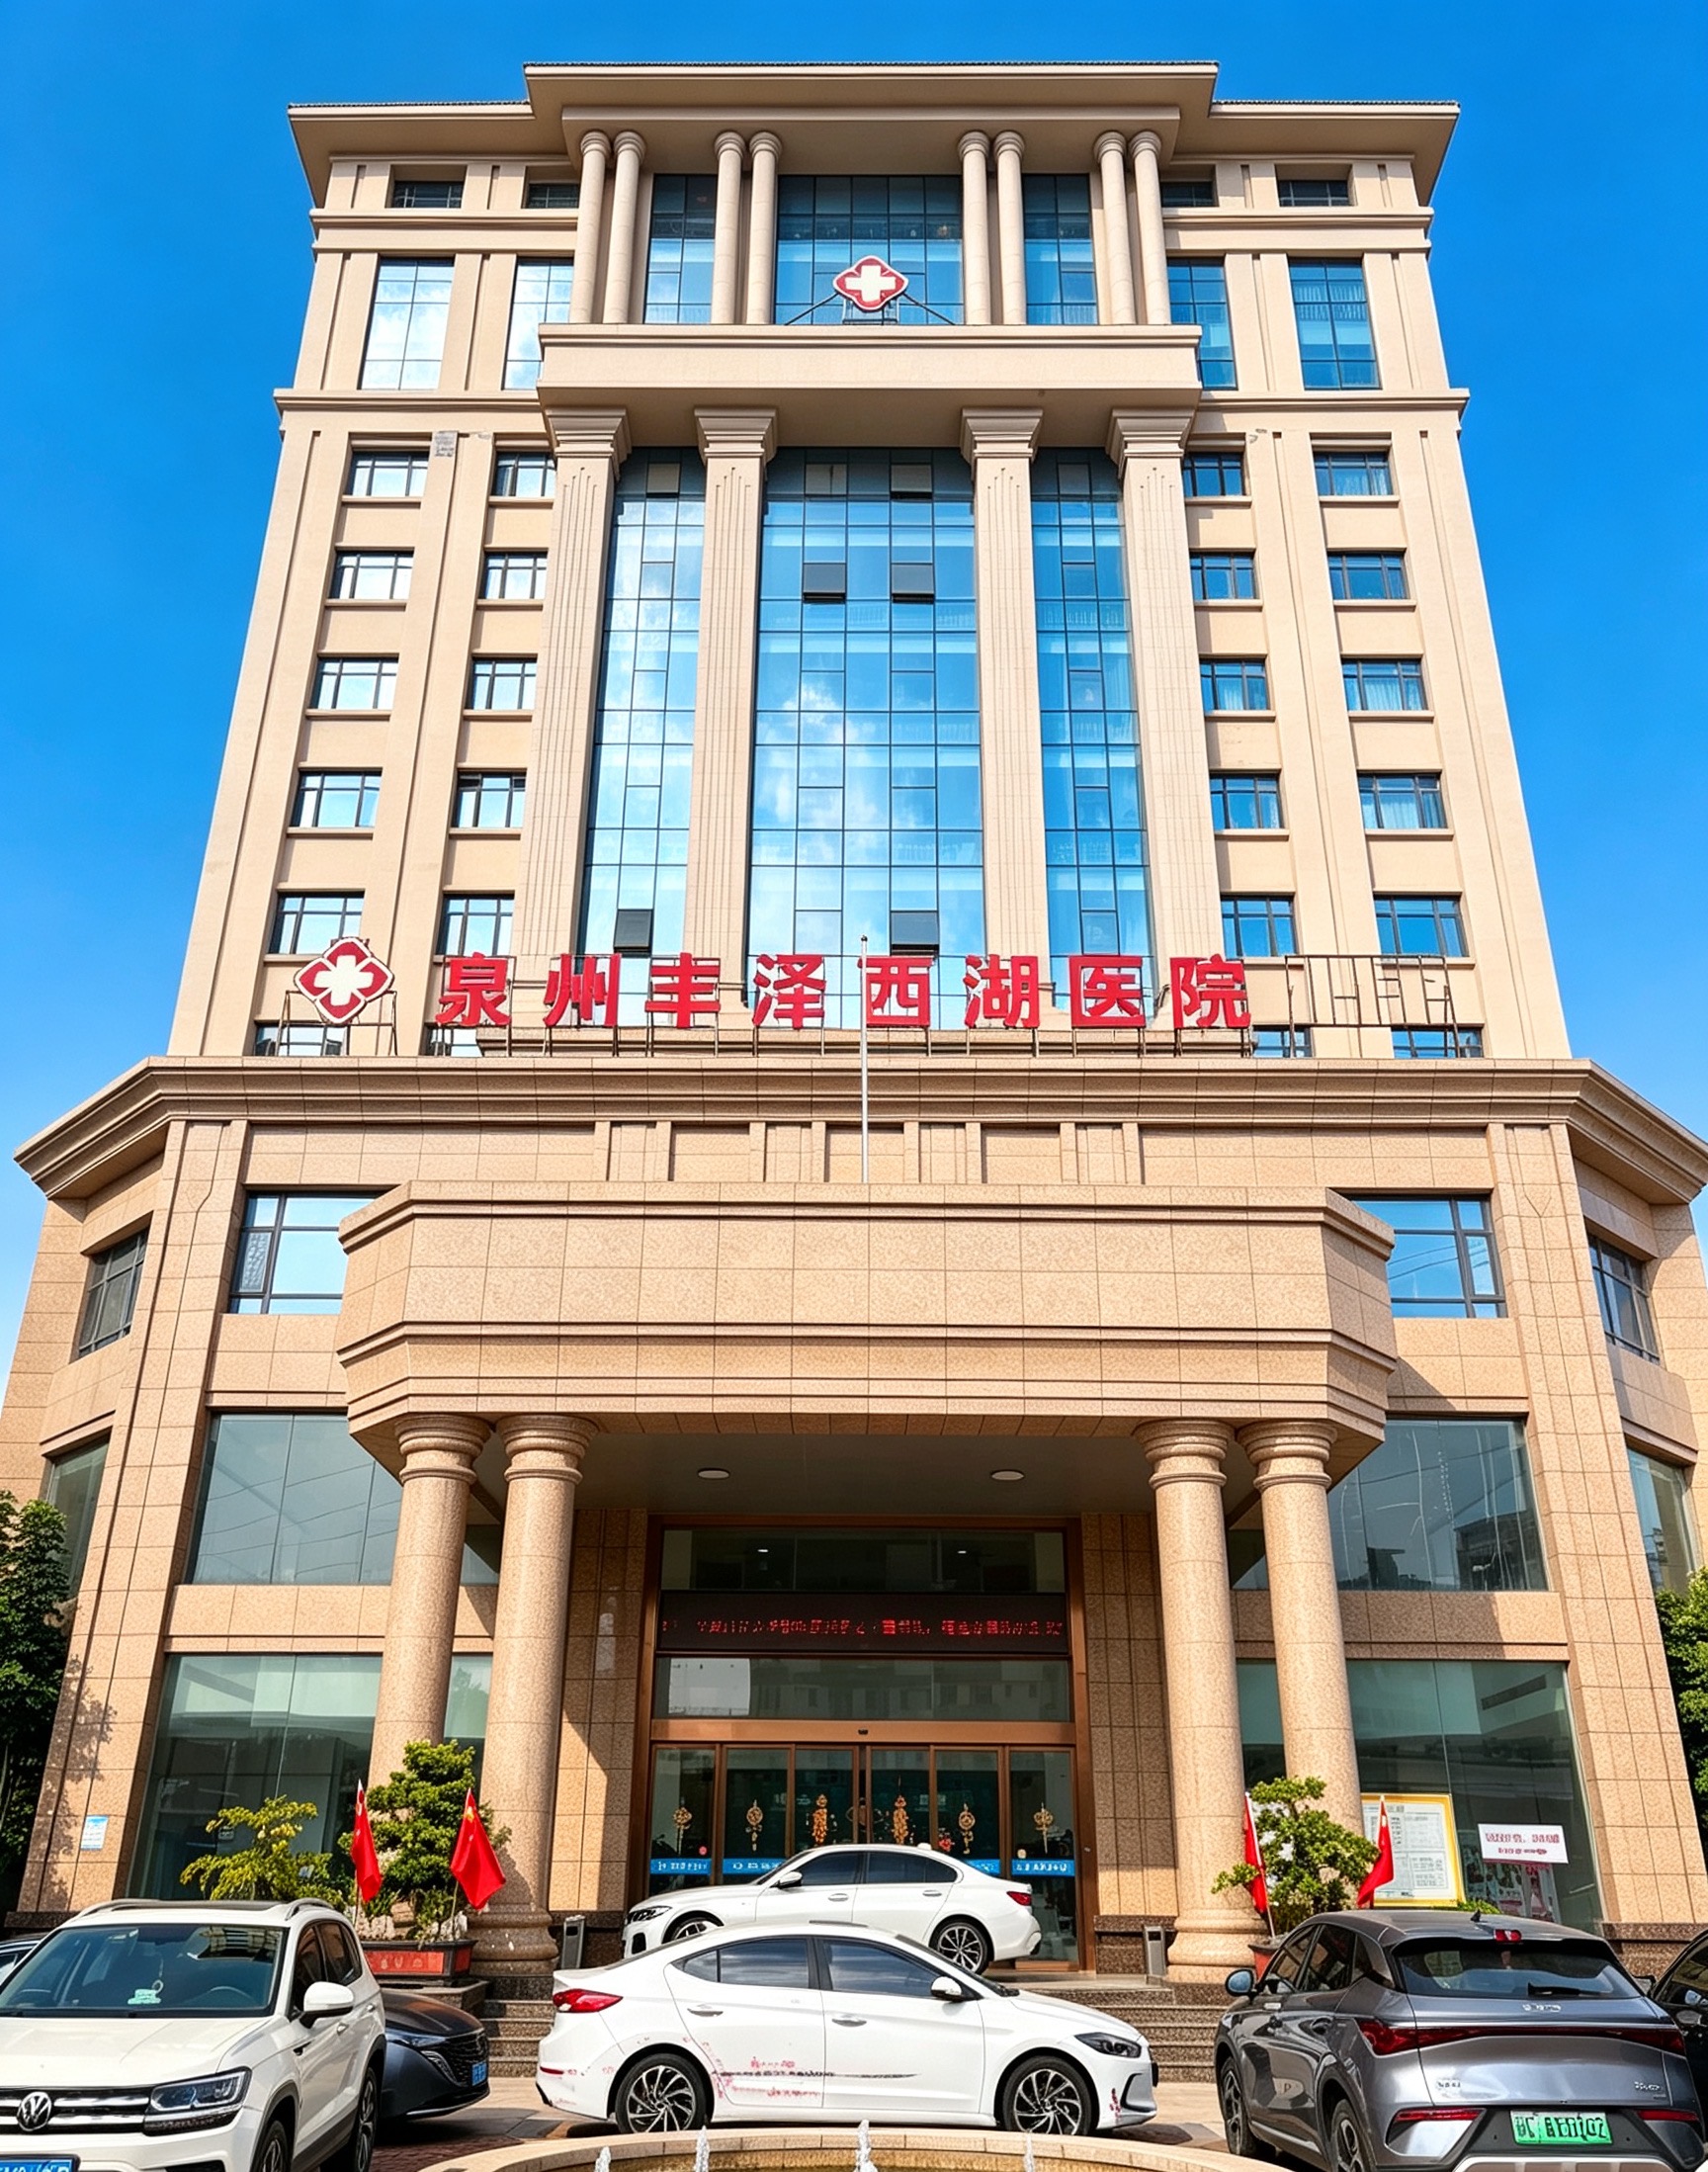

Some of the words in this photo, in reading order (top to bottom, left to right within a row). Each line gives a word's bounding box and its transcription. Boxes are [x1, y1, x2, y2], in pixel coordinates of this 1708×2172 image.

[436, 952, 1252, 1029] 泉州丰泽西湖医院
